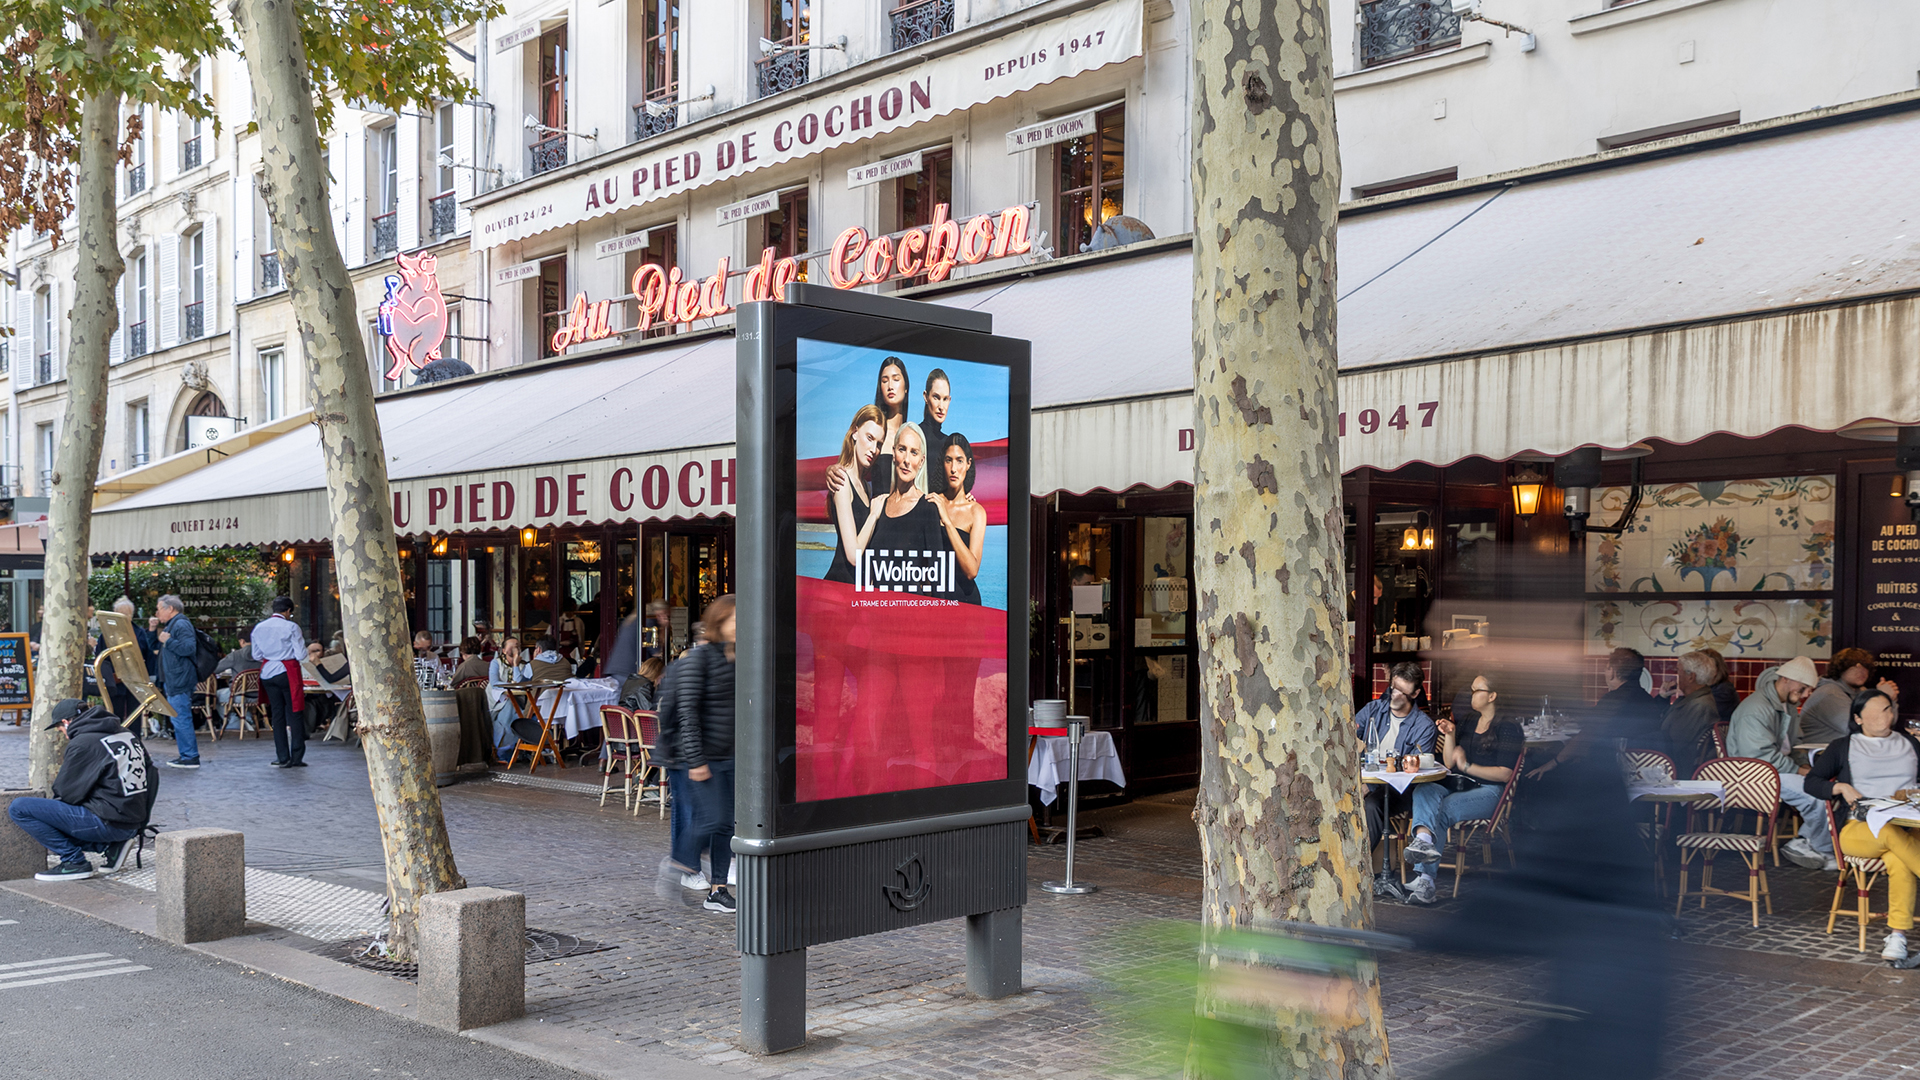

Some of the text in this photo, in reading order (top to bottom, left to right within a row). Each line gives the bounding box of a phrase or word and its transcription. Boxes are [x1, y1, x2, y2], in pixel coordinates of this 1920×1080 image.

[984, 30, 1106, 81] DEPUIS 1947
[586, 76, 931, 211] AU PIED DE COCHON
[1016, 119, 1083, 145] AU PIED DE COCHON
[865, 167, 879, 179] PIED
[881, 164, 888, 175] DE
[890, 157, 913, 172] COCHON
[485, 204, 553, 234] OUVERT 24/24
[731, 207, 742, 218] PIED
[743, 204, 750, 215] DE
[751, 198, 771, 212] COCHON
[552, 202, 1031, 352] Au Pied de Cochon
[1338, 401, 1439, 437] 1947
[428, 480, 515, 525] PIED
[535, 473, 588, 518] DE
[171, 516, 239, 534] OUVERT 24/24
[1880, 524, 1917, 536] AU PIED
[1872, 538, 1920, 551] DE COCHO
[872, 559, 939, 582] Wolford
[1876, 580, 1918, 594] HUÎTRES
[1891, 612, 1901, 621] &
